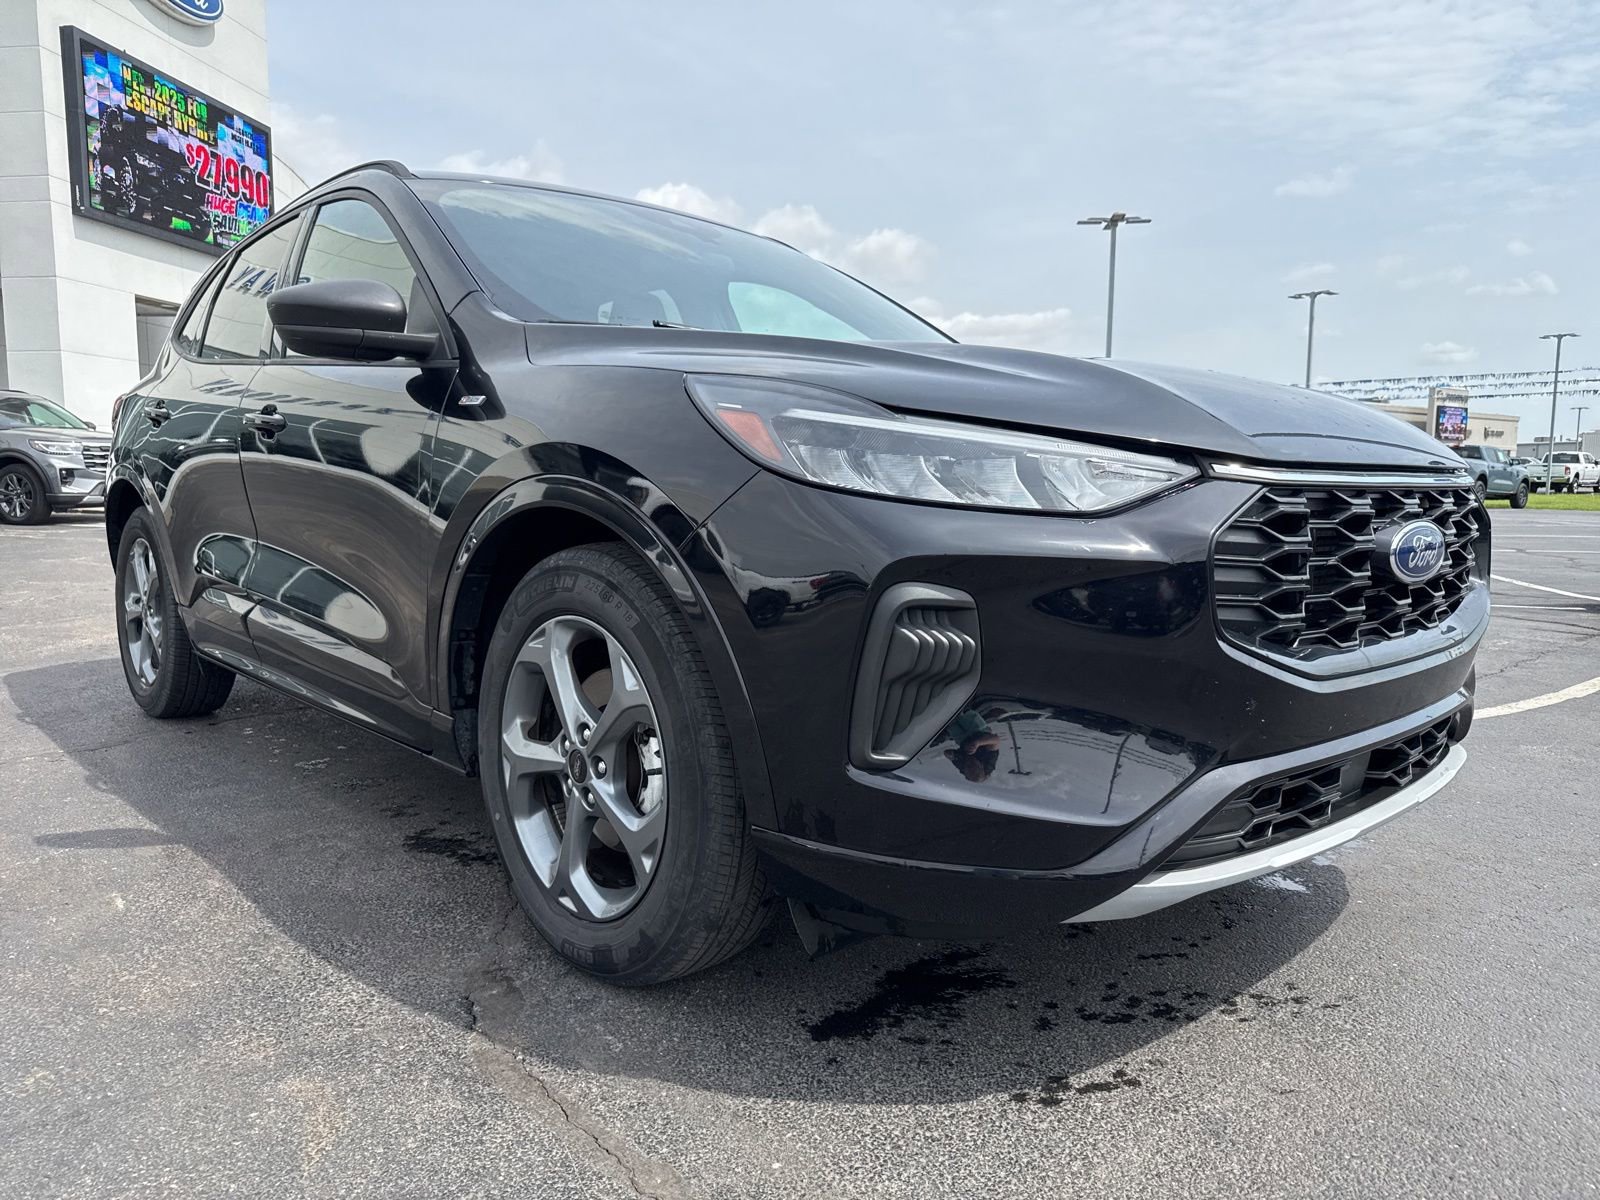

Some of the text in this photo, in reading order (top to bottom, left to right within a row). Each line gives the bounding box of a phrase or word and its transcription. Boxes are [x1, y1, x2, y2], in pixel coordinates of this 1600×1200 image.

[126, 87, 172, 125] ESCAPE
[154, 81, 186, 112] 2025
[204, 193, 237, 216] HUGE
[1408, 535, 1439, 568] Ford
[517, 575, 576, 609] MICHELIN
